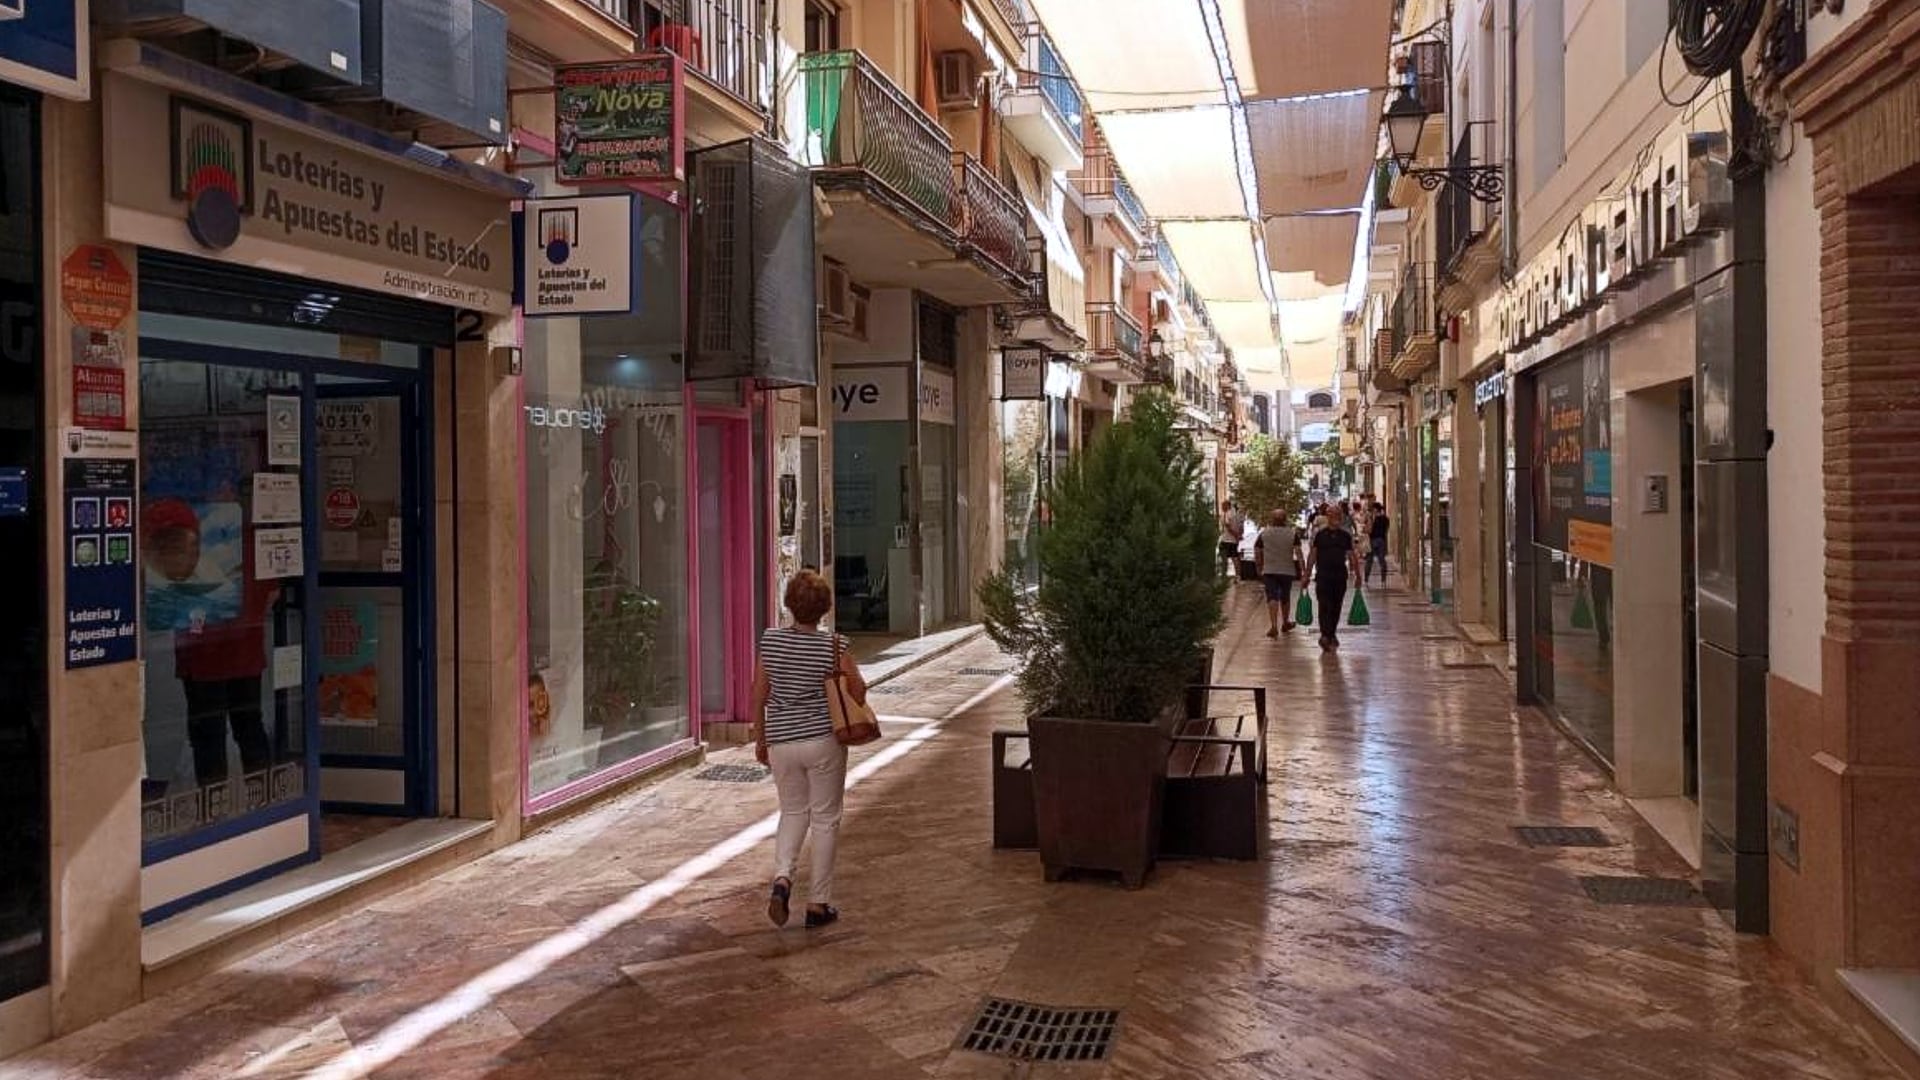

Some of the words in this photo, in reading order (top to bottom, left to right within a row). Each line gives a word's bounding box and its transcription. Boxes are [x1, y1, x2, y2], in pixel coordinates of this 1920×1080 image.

[595, 88, 665, 113] Nova
[259, 139, 364, 199] Loterías
[371, 181, 384, 212] y
[262, 188, 380, 246] Apuestas
[386, 221, 418, 257] del
[424, 230, 490, 272] Estado
[538, 281, 587, 293] Apuestas
[589, 278, 606, 290] del
[538, 294, 574, 305] Estado
[457, 309, 484, 341] 2
[831, 383, 880, 413] ye
[112, 607, 120, 621] y
[69, 627, 117, 644] Apuestas
[70, 647, 105, 661] Estado
